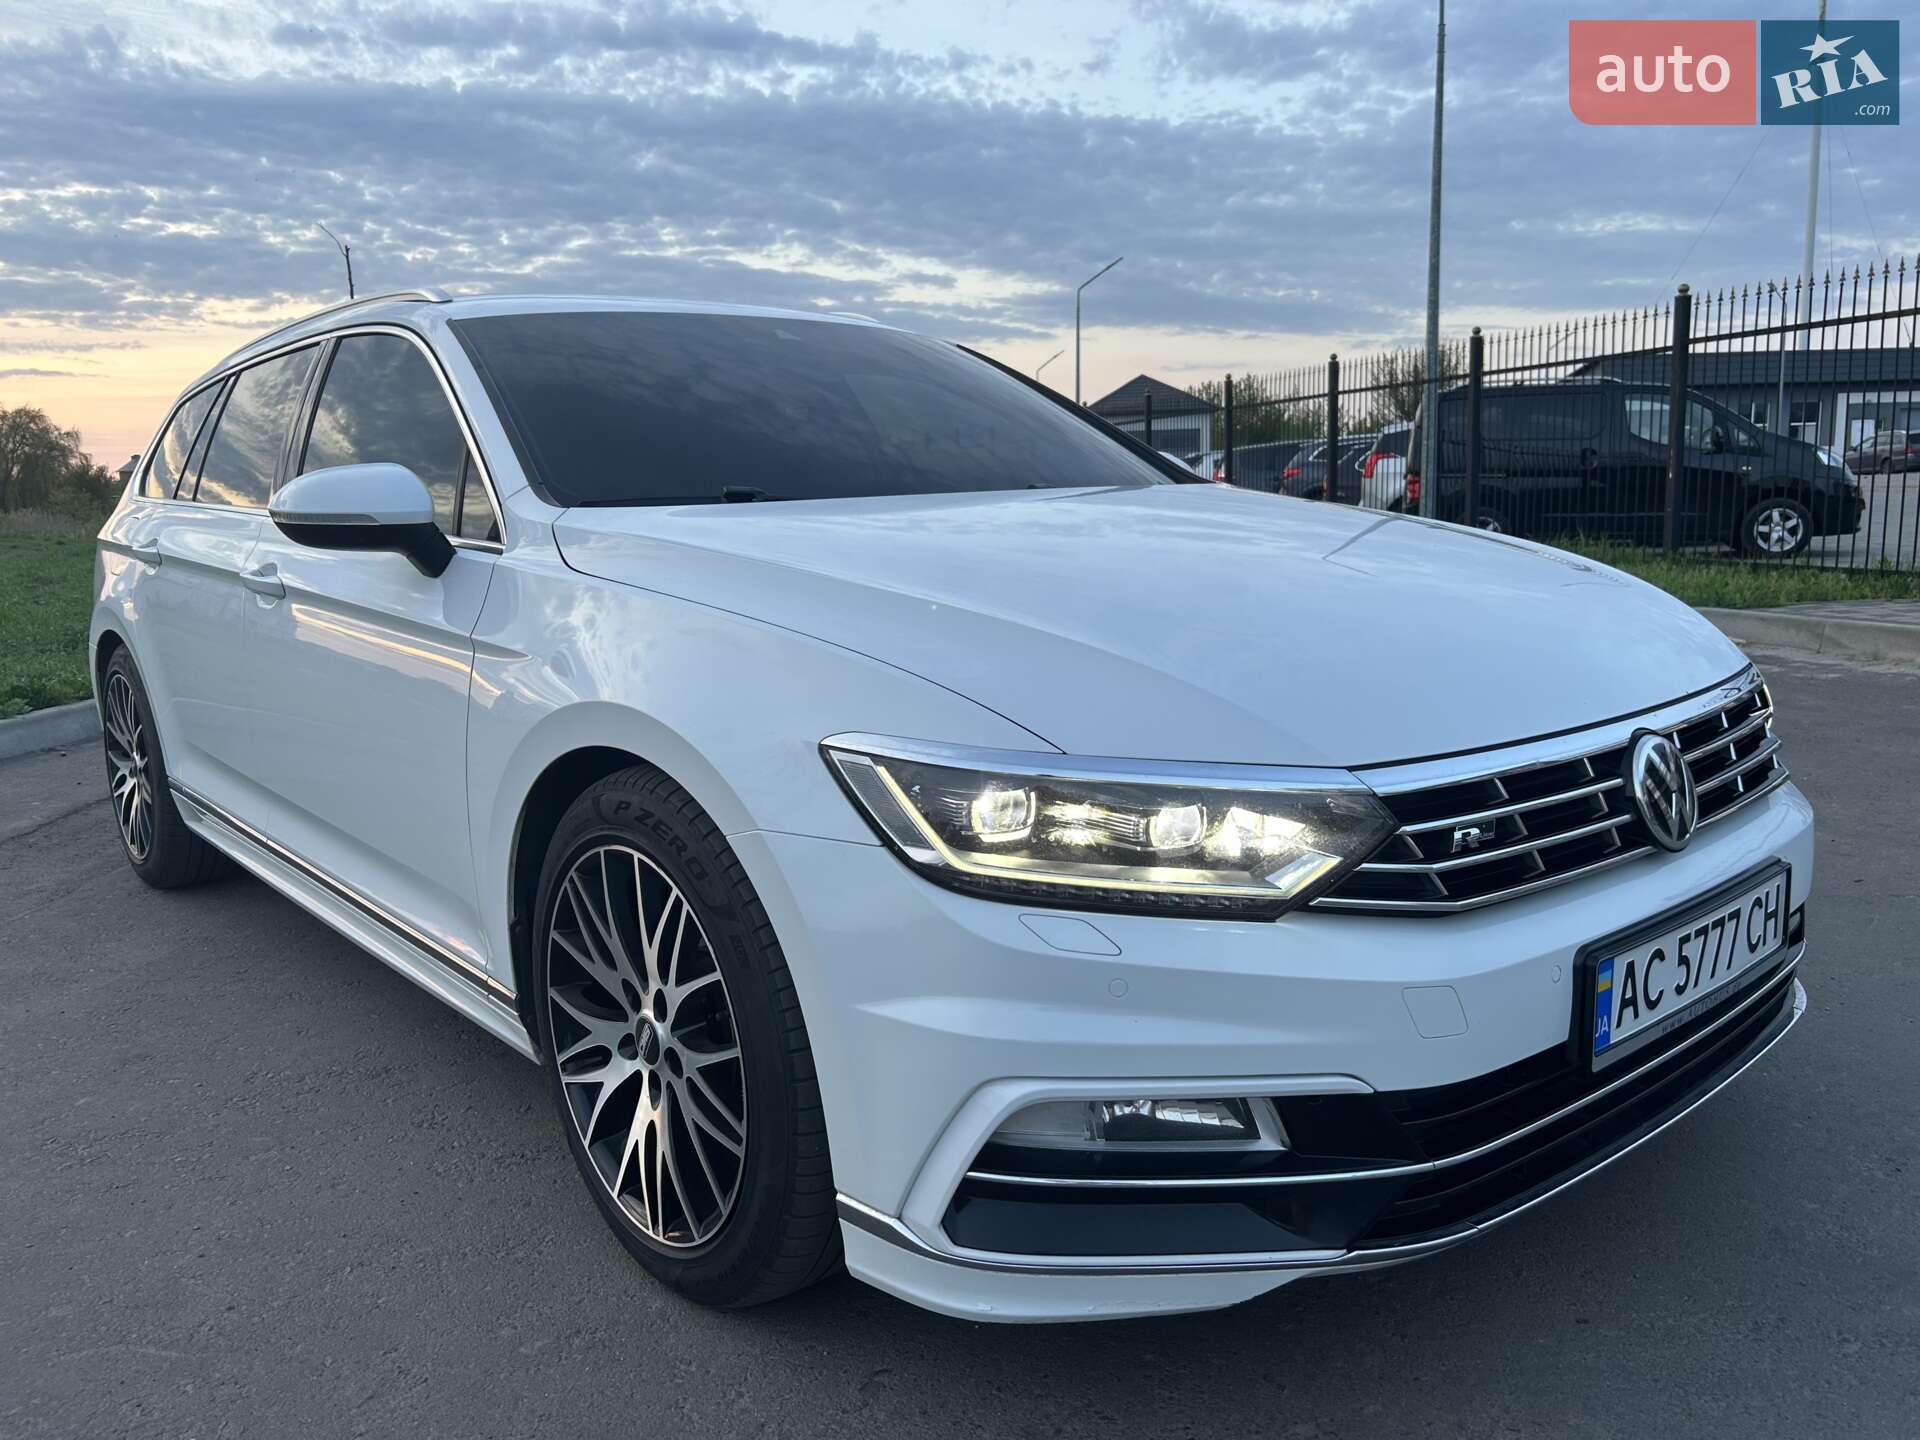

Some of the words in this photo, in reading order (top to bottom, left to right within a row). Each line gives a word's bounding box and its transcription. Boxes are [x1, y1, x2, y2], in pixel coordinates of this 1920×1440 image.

[614, 800, 631, 815] P
[634, 807, 709, 882] ZERO
[1616, 947, 1666, 1029] AC
[1674, 906, 1741, 996] 5777
[1747, 884, 1781, 954] CH
